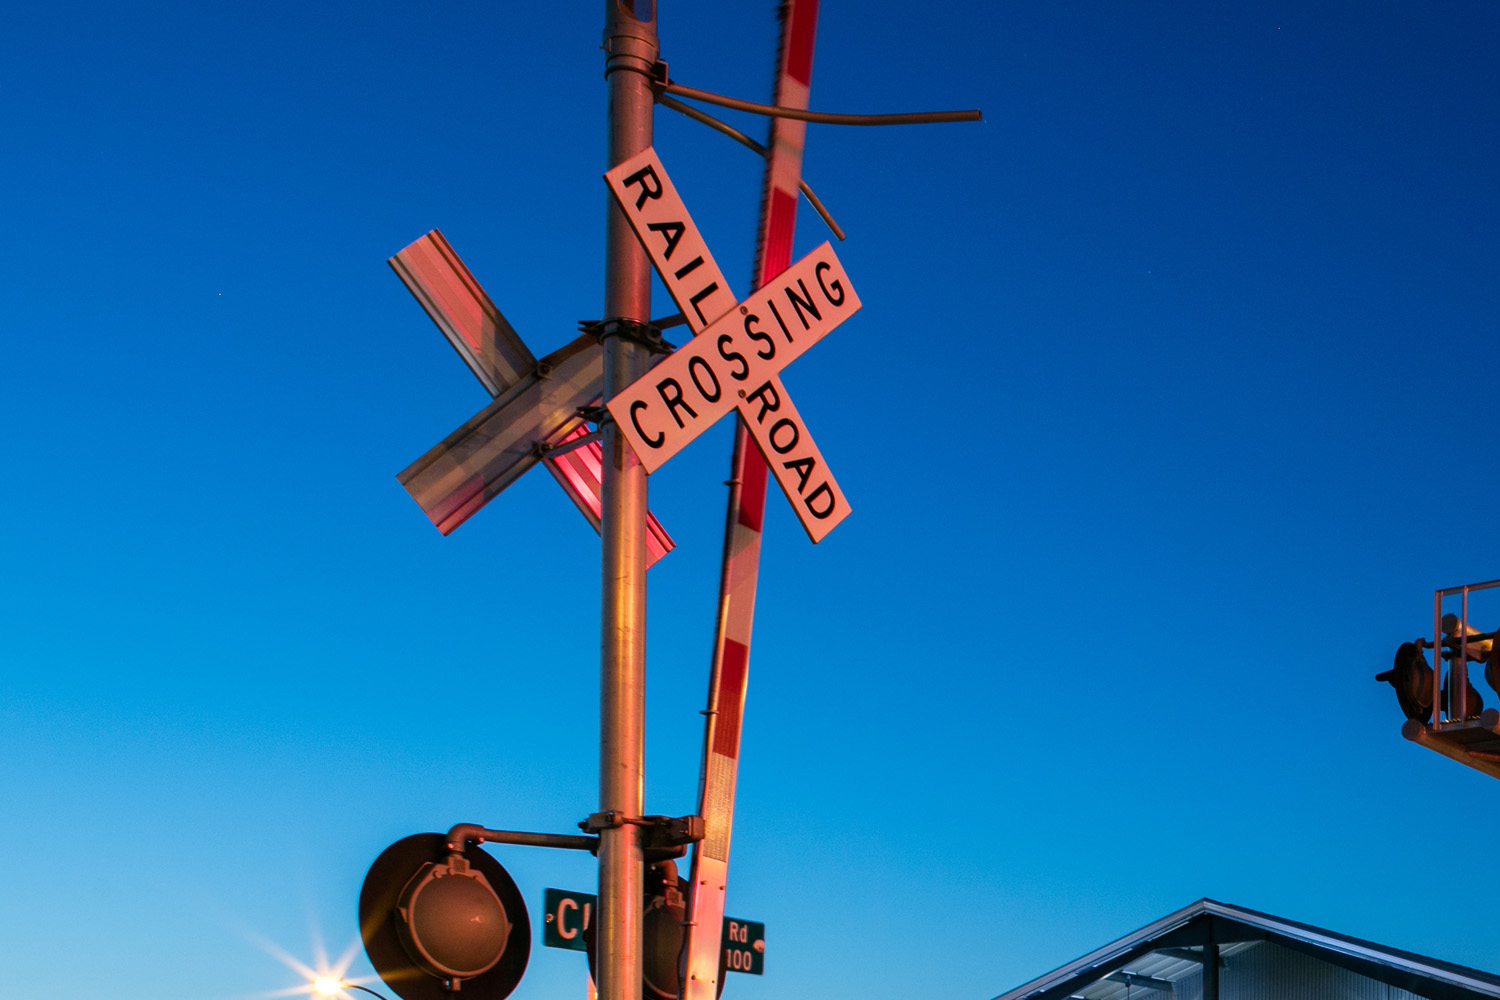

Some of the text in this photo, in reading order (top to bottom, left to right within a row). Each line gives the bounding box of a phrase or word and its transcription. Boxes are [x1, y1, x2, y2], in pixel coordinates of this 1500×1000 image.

[622, 164, 836, 520] RAIL ROAD
[629, 261, 846, 449] CROSSING
[729, 921, 747, 943] Rd
